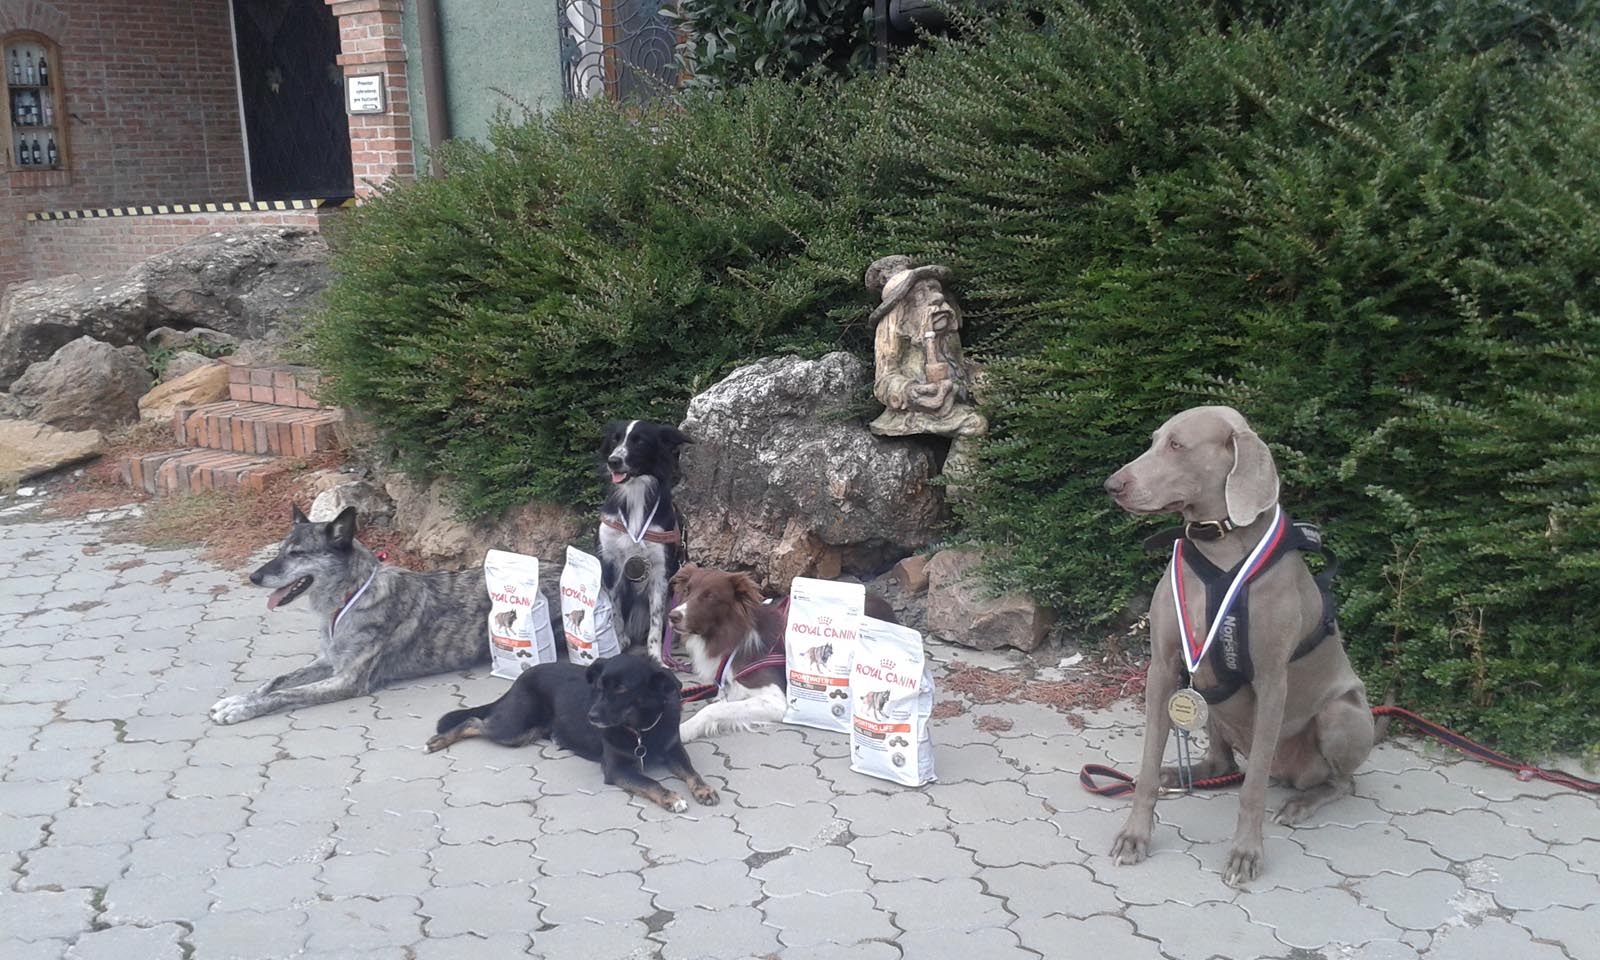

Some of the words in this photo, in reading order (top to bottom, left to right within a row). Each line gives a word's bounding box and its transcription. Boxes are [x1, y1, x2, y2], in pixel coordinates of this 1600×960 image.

[792, 623, 822, 636] ROYAL
[824, 627, 857, 640] CANIN
[856, 664, 882, 680] ROYAL
[885, 673, 916, 689] CANIN
